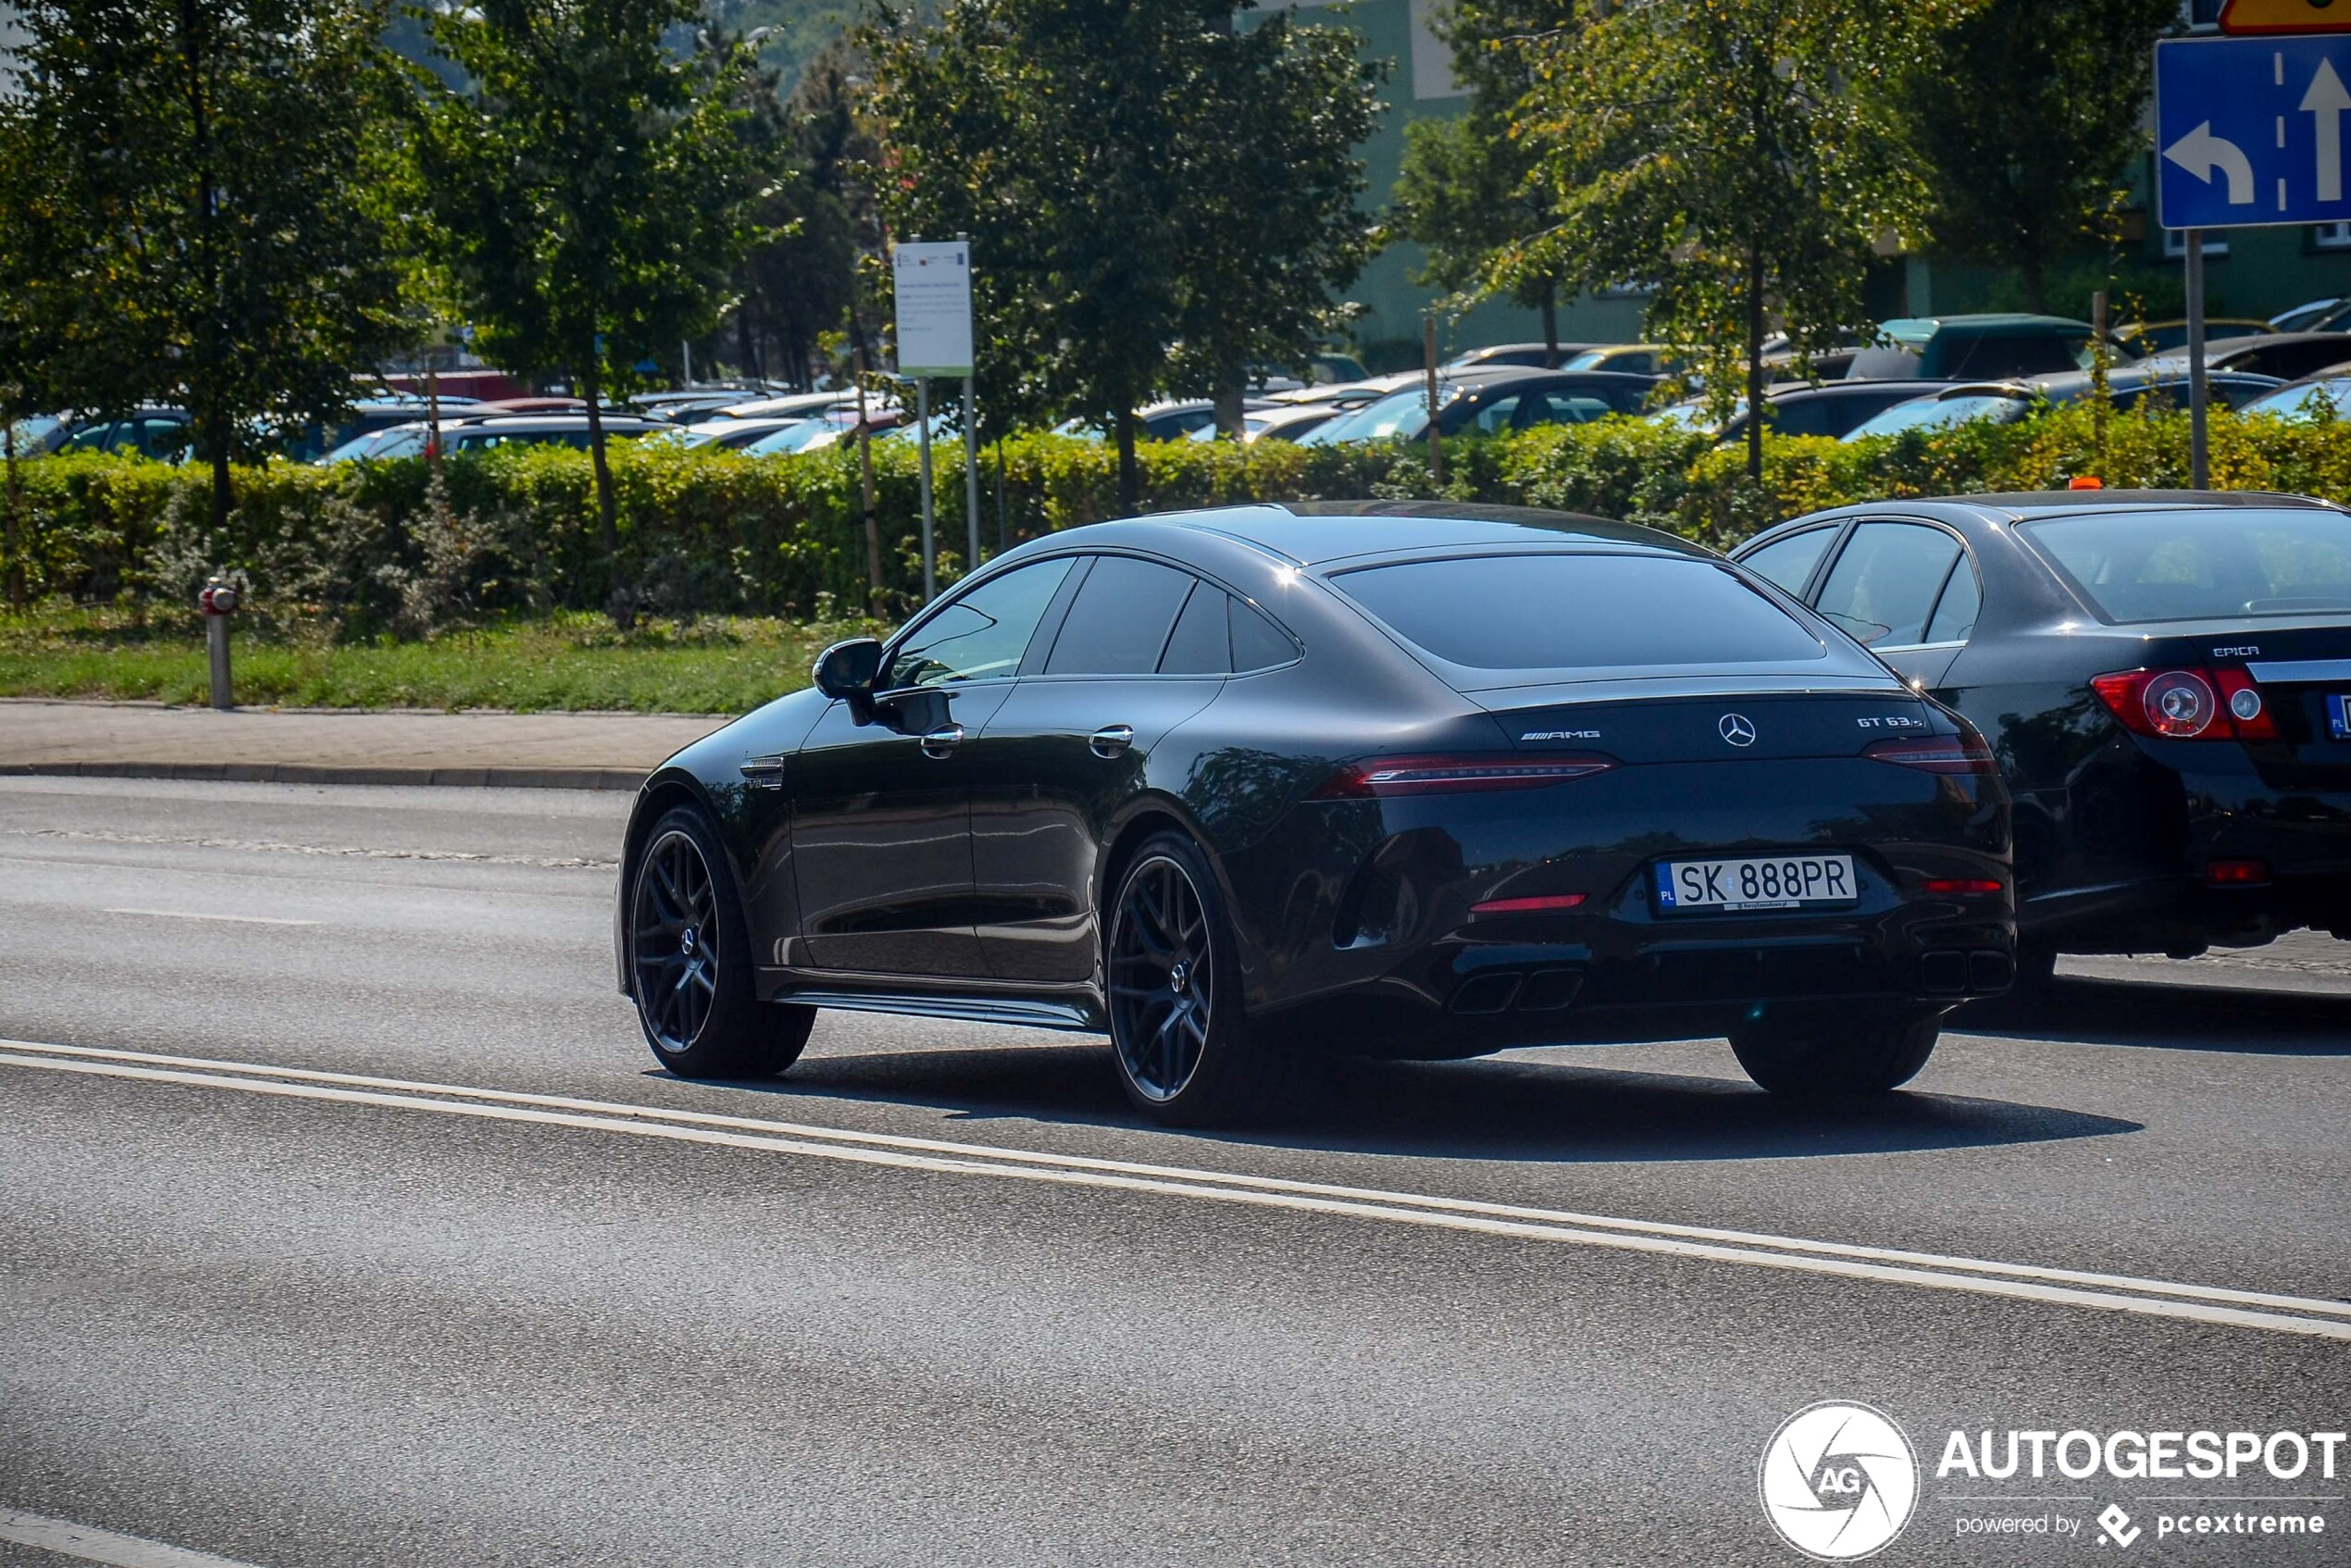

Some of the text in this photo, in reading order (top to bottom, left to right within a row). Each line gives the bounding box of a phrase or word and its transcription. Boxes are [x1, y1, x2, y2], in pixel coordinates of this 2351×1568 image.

[2213, 646, 2259, 657] EPICA
[1857, 717, 1881, 728] GT
[1885, 716, 1910, 727] 63
[2332, 718, 2344, 728] PL
[1547, 730, 1600, 740] AMG
[1681, 860, 1847, 902] SK 888PR
[1661, 891, 1673, 901] PL
